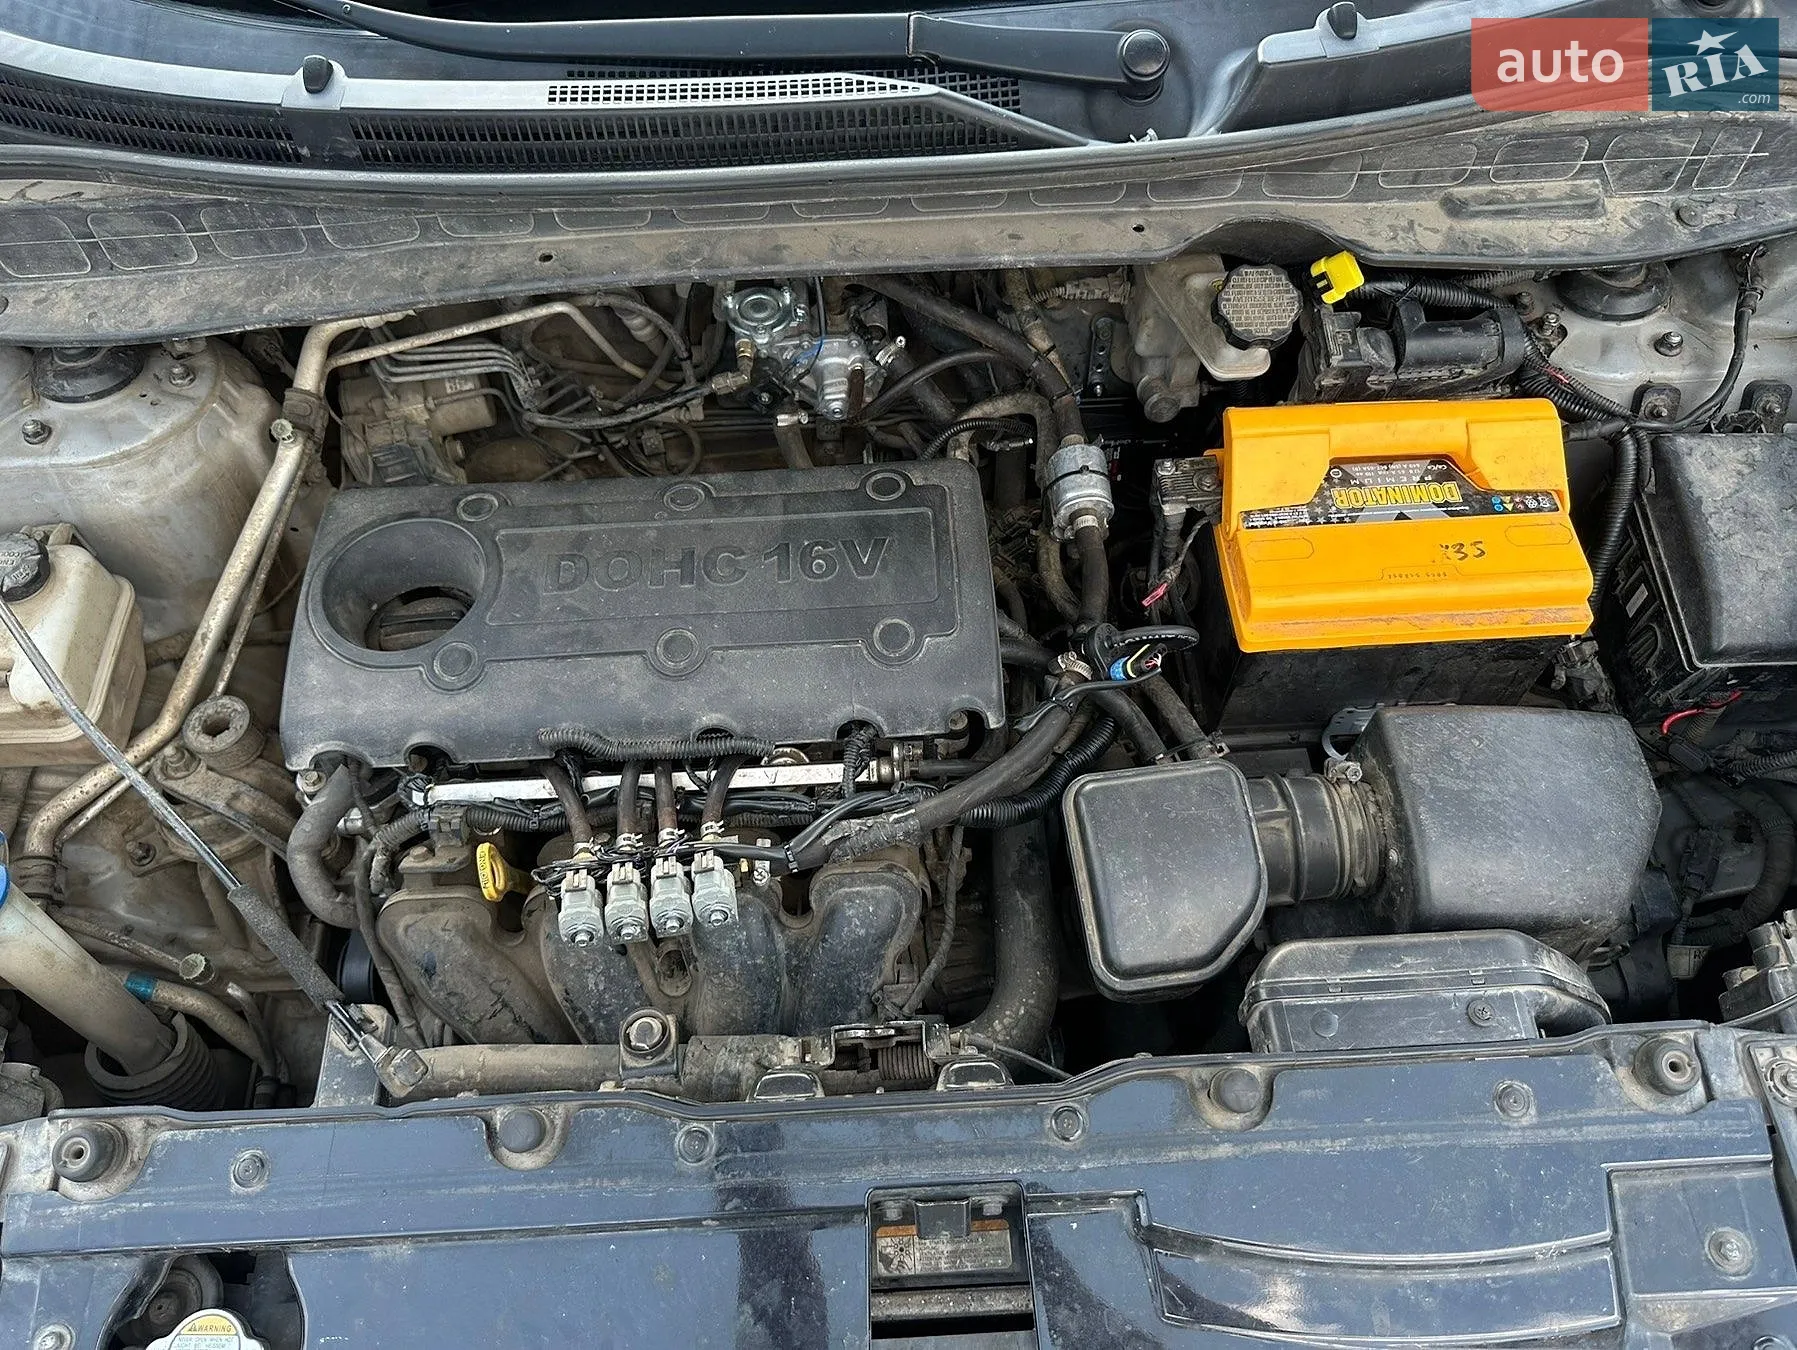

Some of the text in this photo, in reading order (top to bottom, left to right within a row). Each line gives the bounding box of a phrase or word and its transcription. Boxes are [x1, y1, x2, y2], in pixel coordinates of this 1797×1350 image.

[1350, 475, 1432, 486] PREMIUM
[1331, 482, 1463, 509] DOMINATOR
[542, 535, 890, 595] DOHC 16V
[197, 1324, 232, 1333] WARNING
